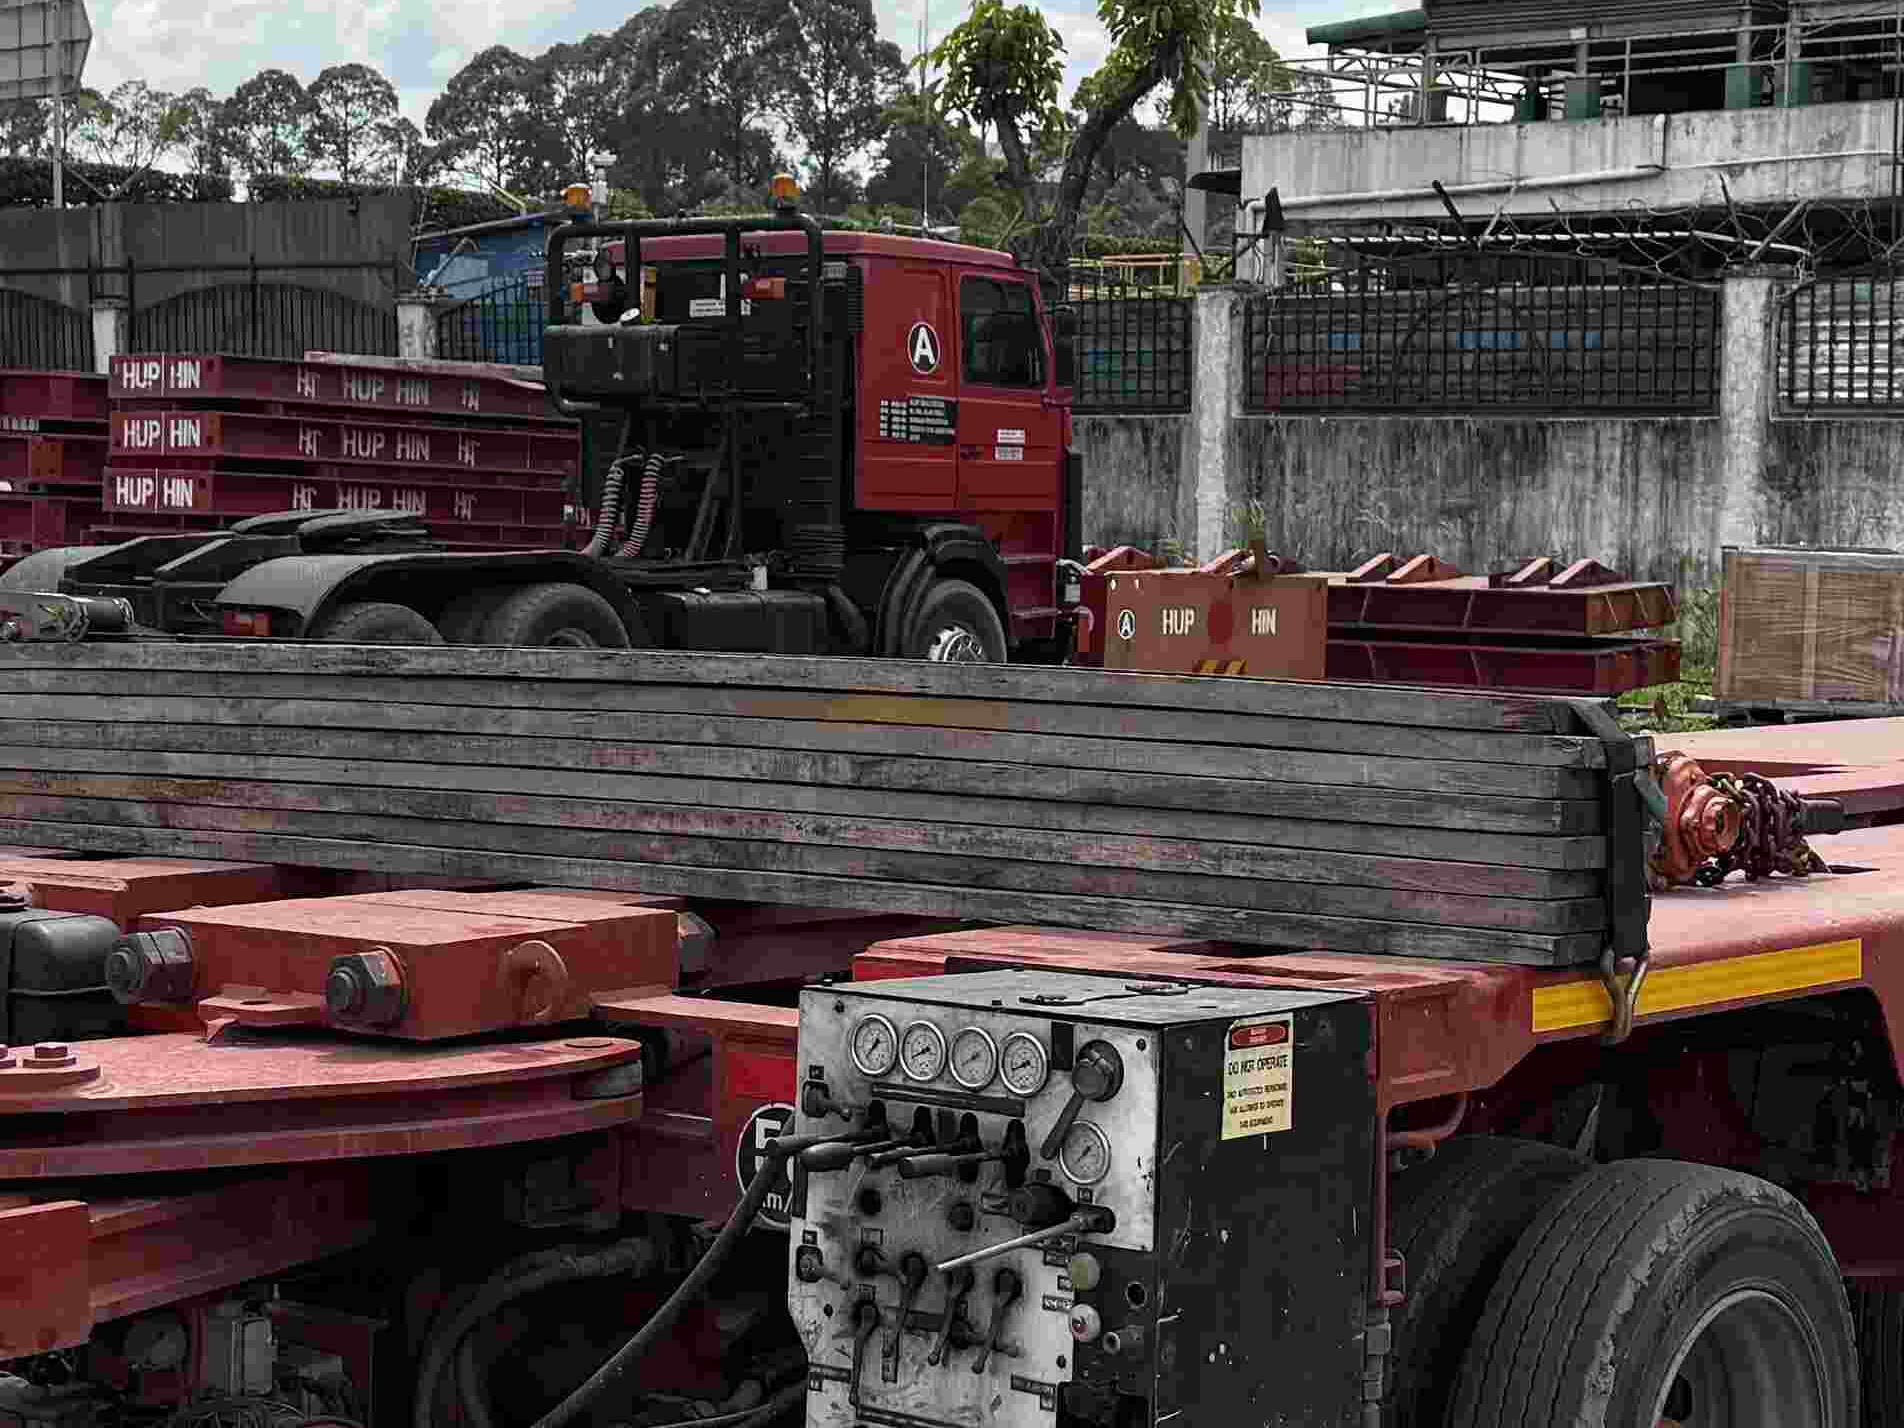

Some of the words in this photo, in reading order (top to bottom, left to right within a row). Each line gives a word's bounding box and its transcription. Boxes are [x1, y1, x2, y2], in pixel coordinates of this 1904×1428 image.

[122, 361, 160, 390] HUP
[170, 360, 200, 389] HIN
[343, 371, 385, 402] HUP
[396, 379, 431, 405] HIN
[123, 419, 160, 448] HUP
[170, 419, 200, 448] HIN
[343, 427, 386, 458] HUP
[396, 434, 431, 461] HIN
[116, 475, 154, 506] HUP
[162, 478, 194, 507] HIN
[336, 483, 382, 510] HUP
[392, 489, 427, 516] HIN
[1162, 608, 1195, 636] HUP
[1251, 608, 1277, 636] HIN
[755, 1117, 794, 1184] 5
